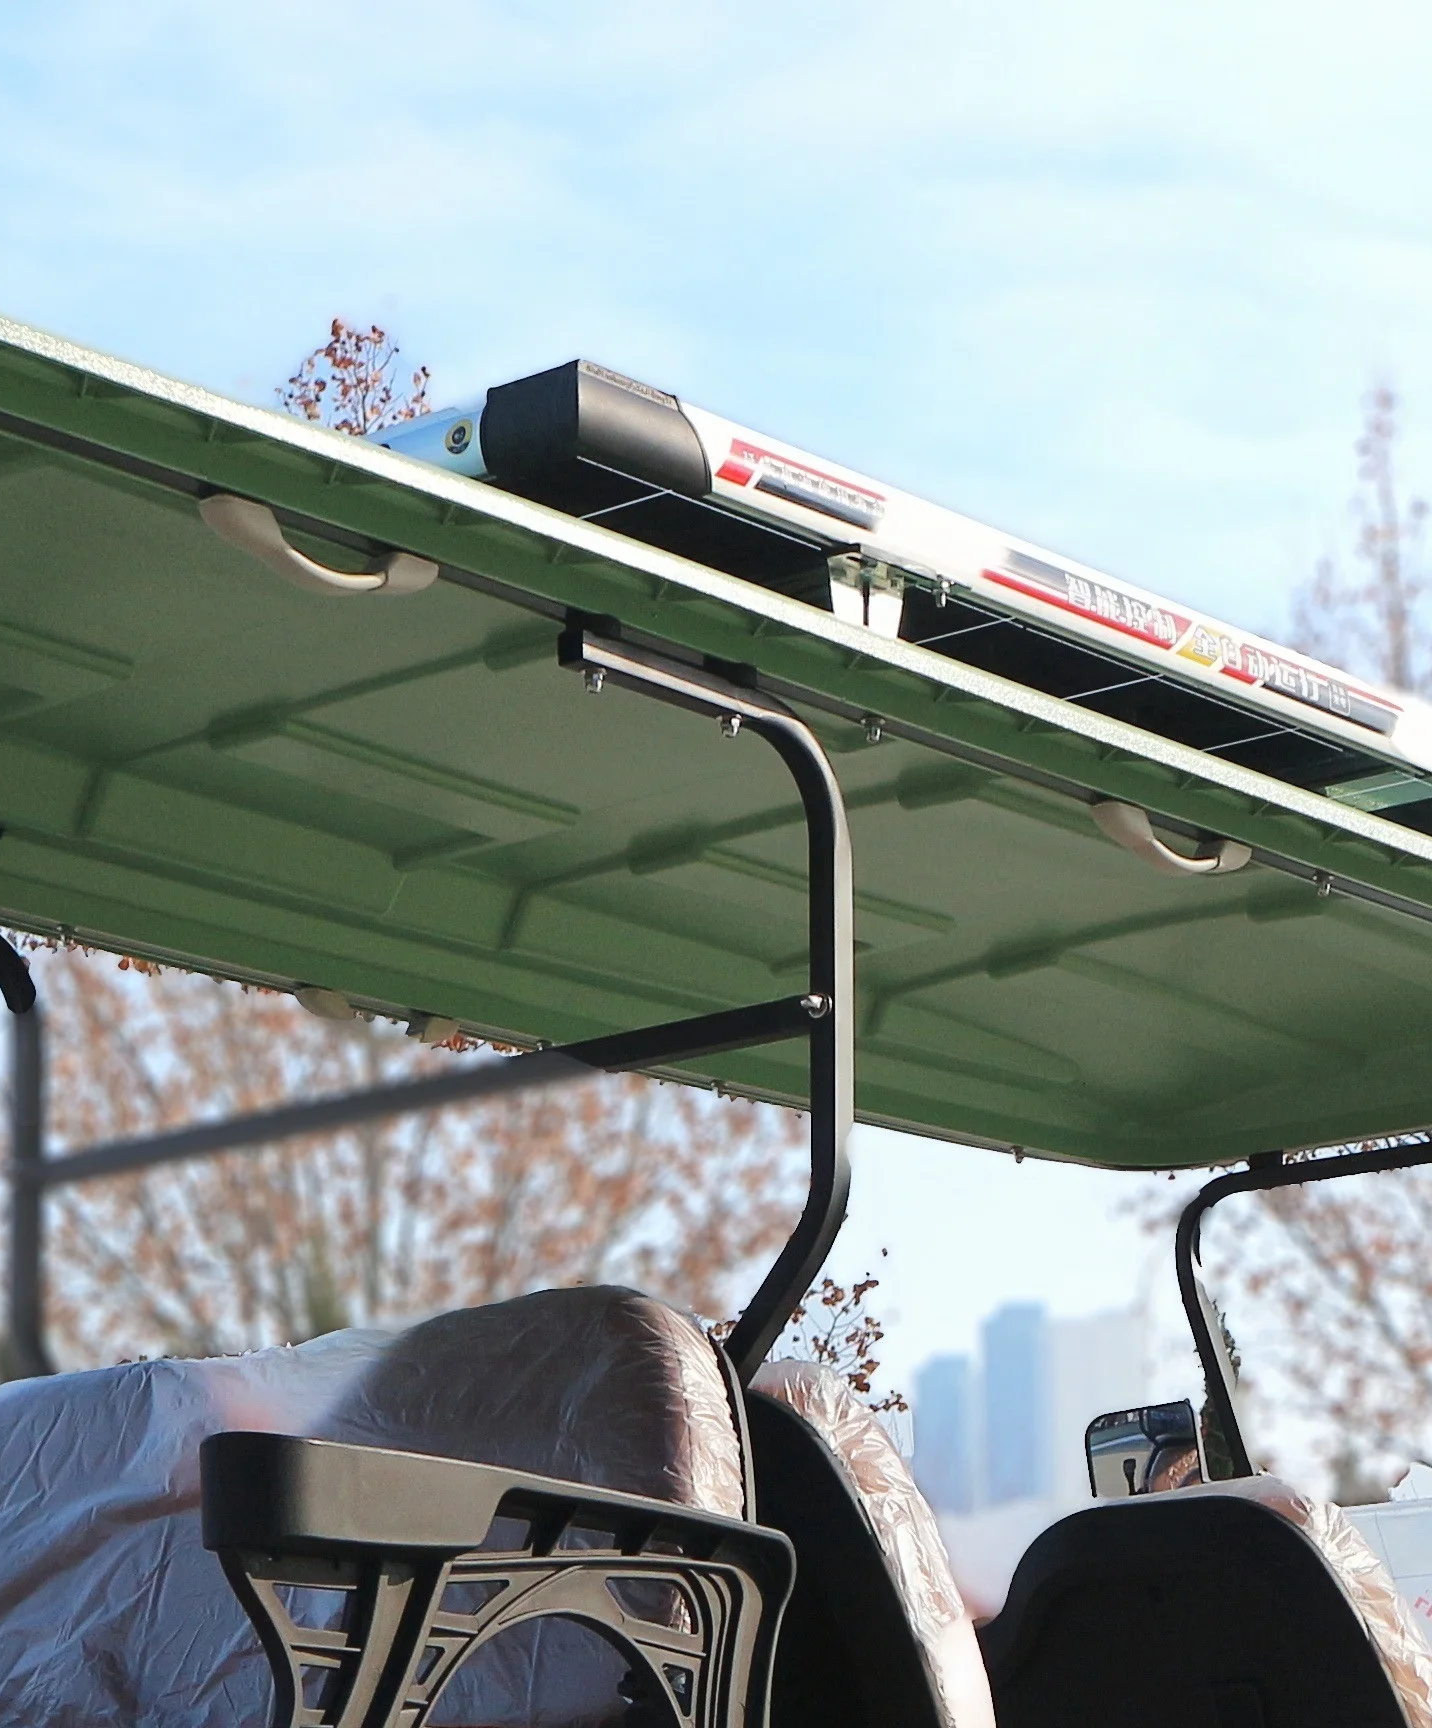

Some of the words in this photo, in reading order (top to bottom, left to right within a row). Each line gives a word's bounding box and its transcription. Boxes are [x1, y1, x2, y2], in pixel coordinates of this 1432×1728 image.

[1065, 572, 1179, 647] 智能控制
[1191, 624, 1329, 703] 全自动运行
